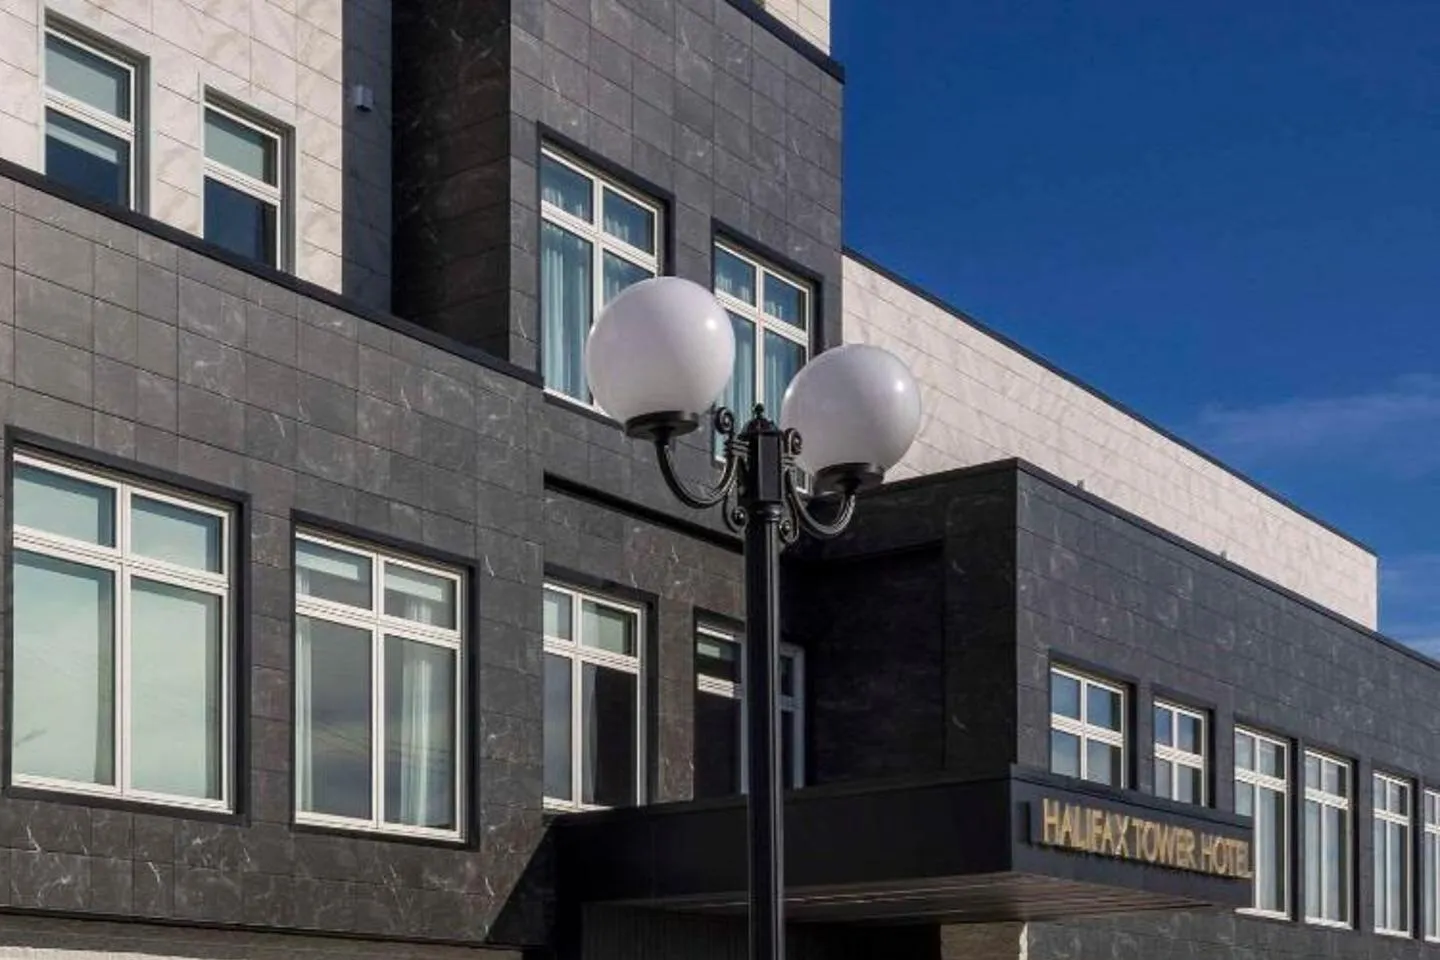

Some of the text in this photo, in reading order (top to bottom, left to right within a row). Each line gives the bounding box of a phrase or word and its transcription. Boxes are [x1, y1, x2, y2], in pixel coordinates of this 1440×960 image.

[1042, 798, 1254, 878] HALIFAX TOWER HOTEL
